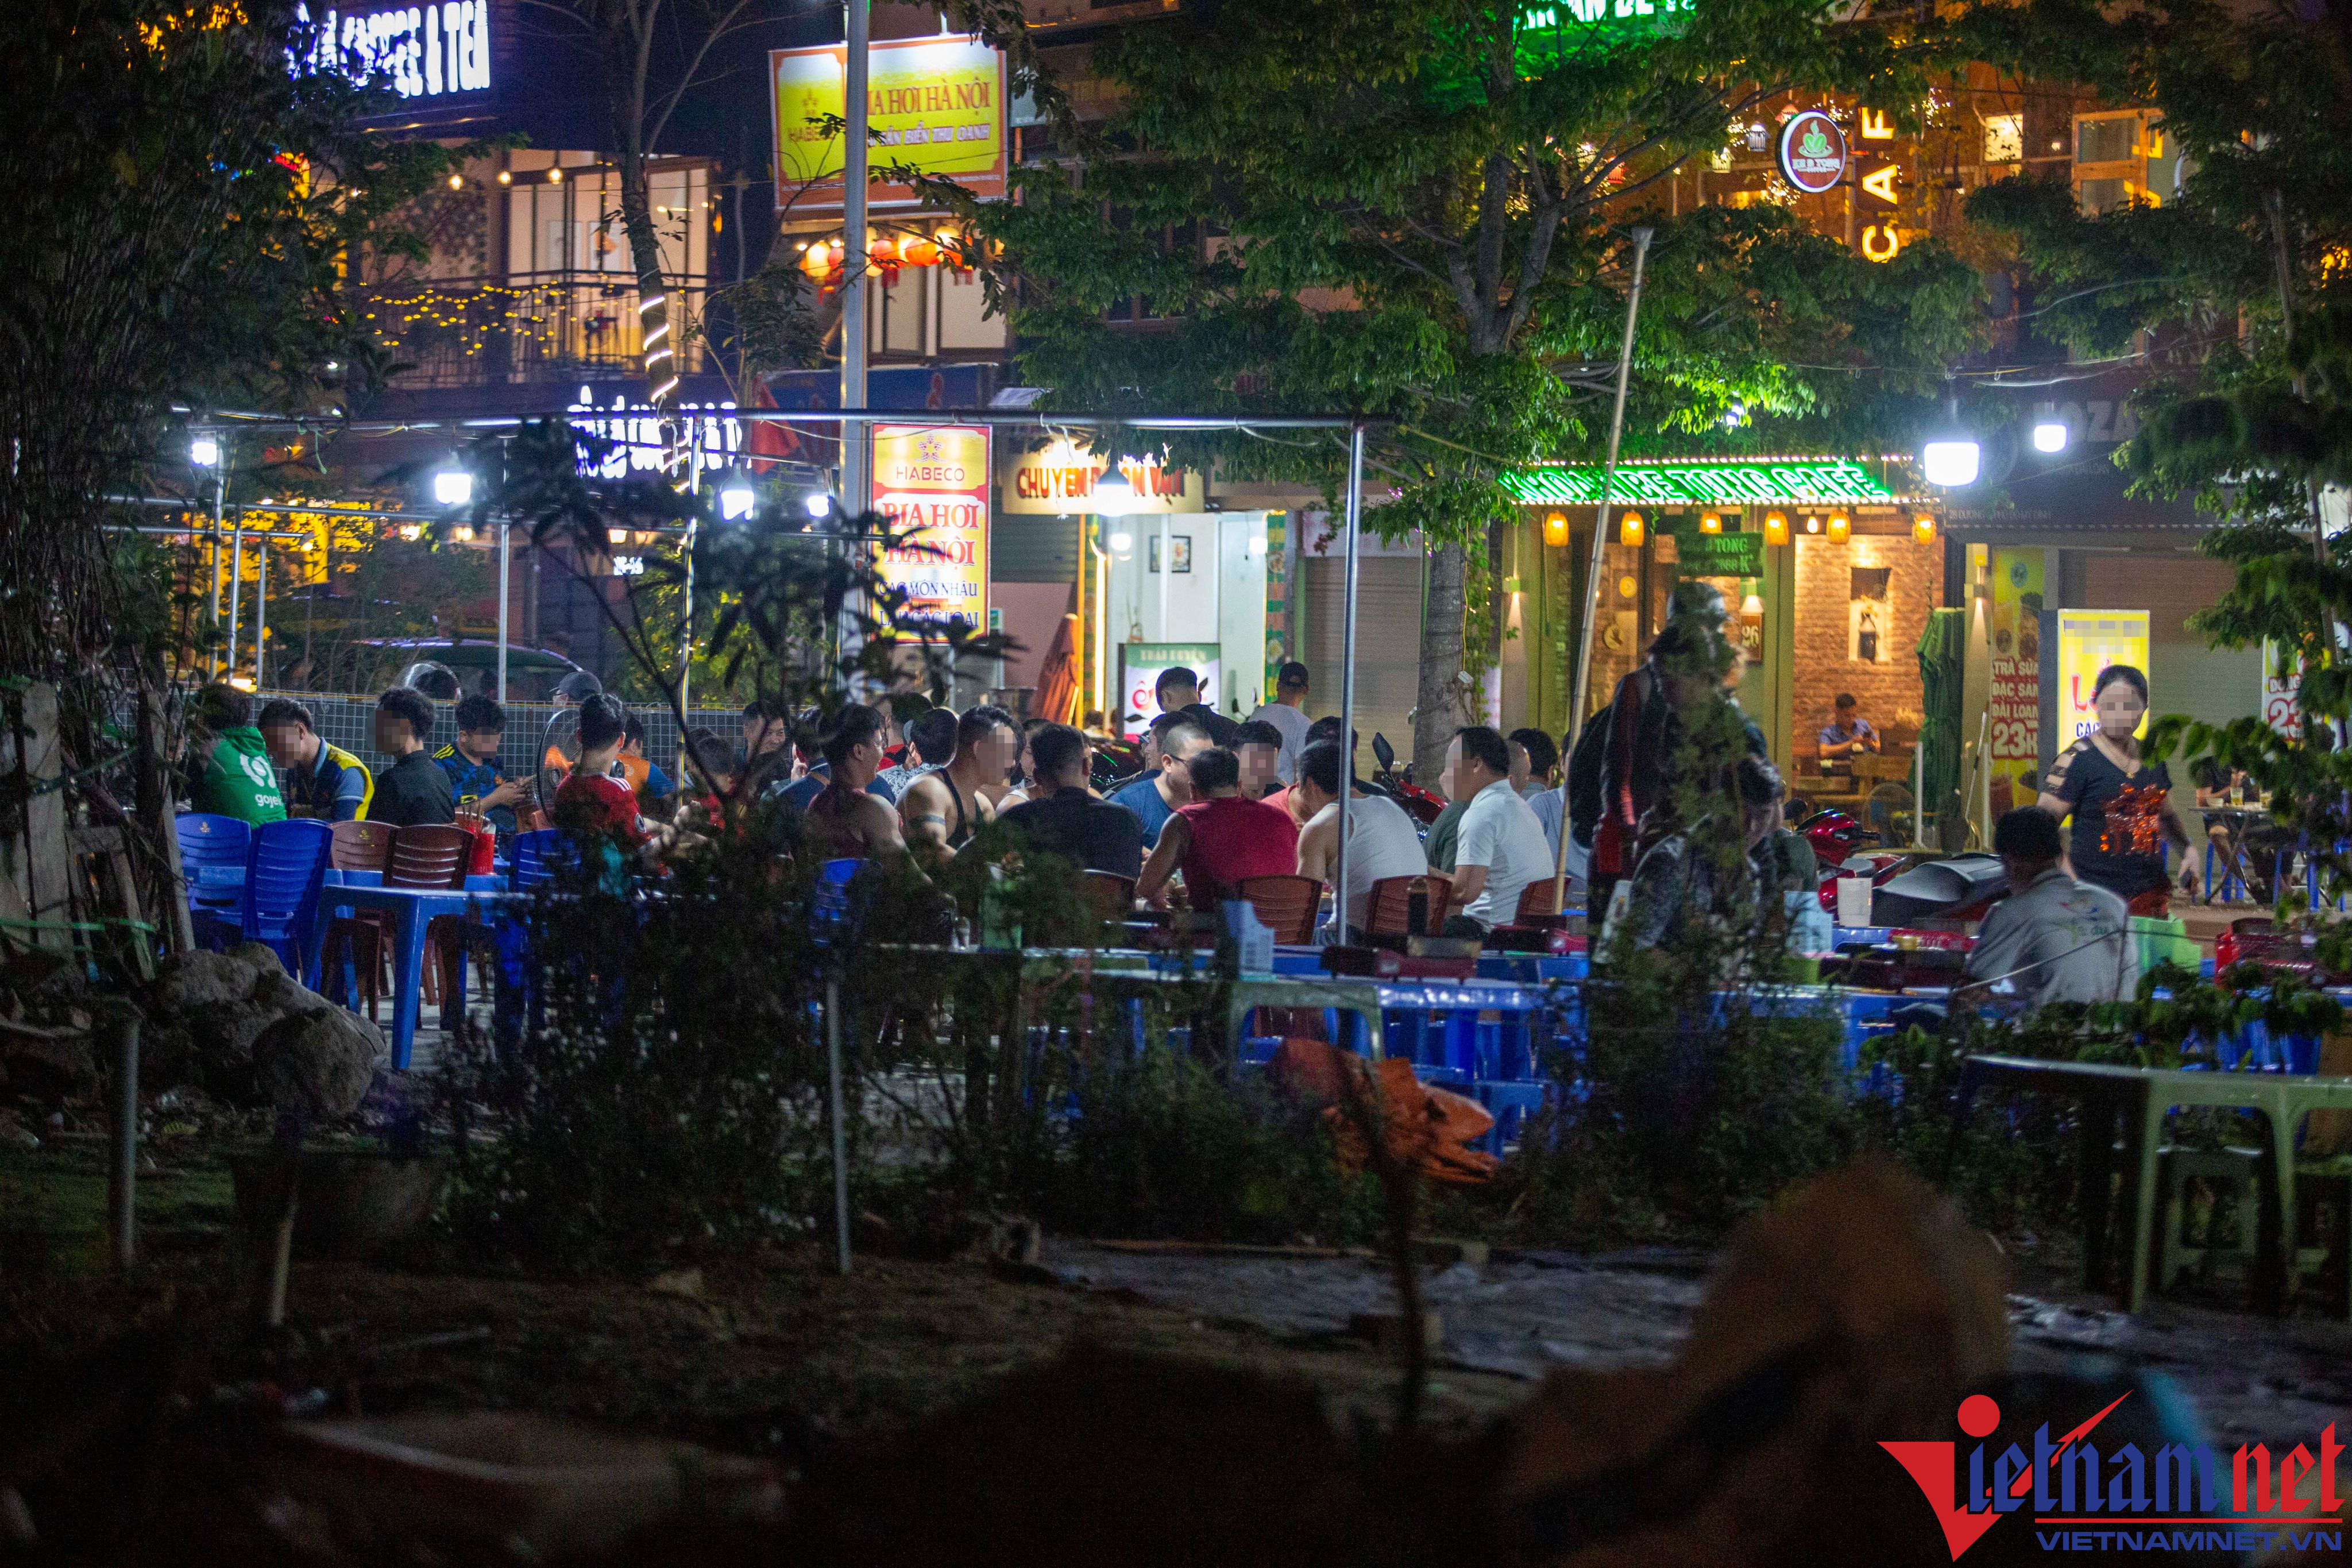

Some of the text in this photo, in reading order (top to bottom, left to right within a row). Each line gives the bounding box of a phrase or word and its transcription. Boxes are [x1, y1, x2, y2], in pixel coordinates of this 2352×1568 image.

[868, 76, 990, 115] IA HƠI HÀ NỘI
[787, 126, 834, 142] HABE
[956, 123, 990, 141] OANH
[897, 466, 965, 481] HABECO
[1017, 461, 1087, 498] CHUYÊN
[883, 503, 979, 528] BIA HƠI
[886, 532, 975, 570] HÀ NỘI
[909, 579, 939, 596] MÓN
[940, 580, 978, 599] NHẬU
[1741, 625, 1759, 647] 26
[1994, 659, 2015, 676] TRÀ
